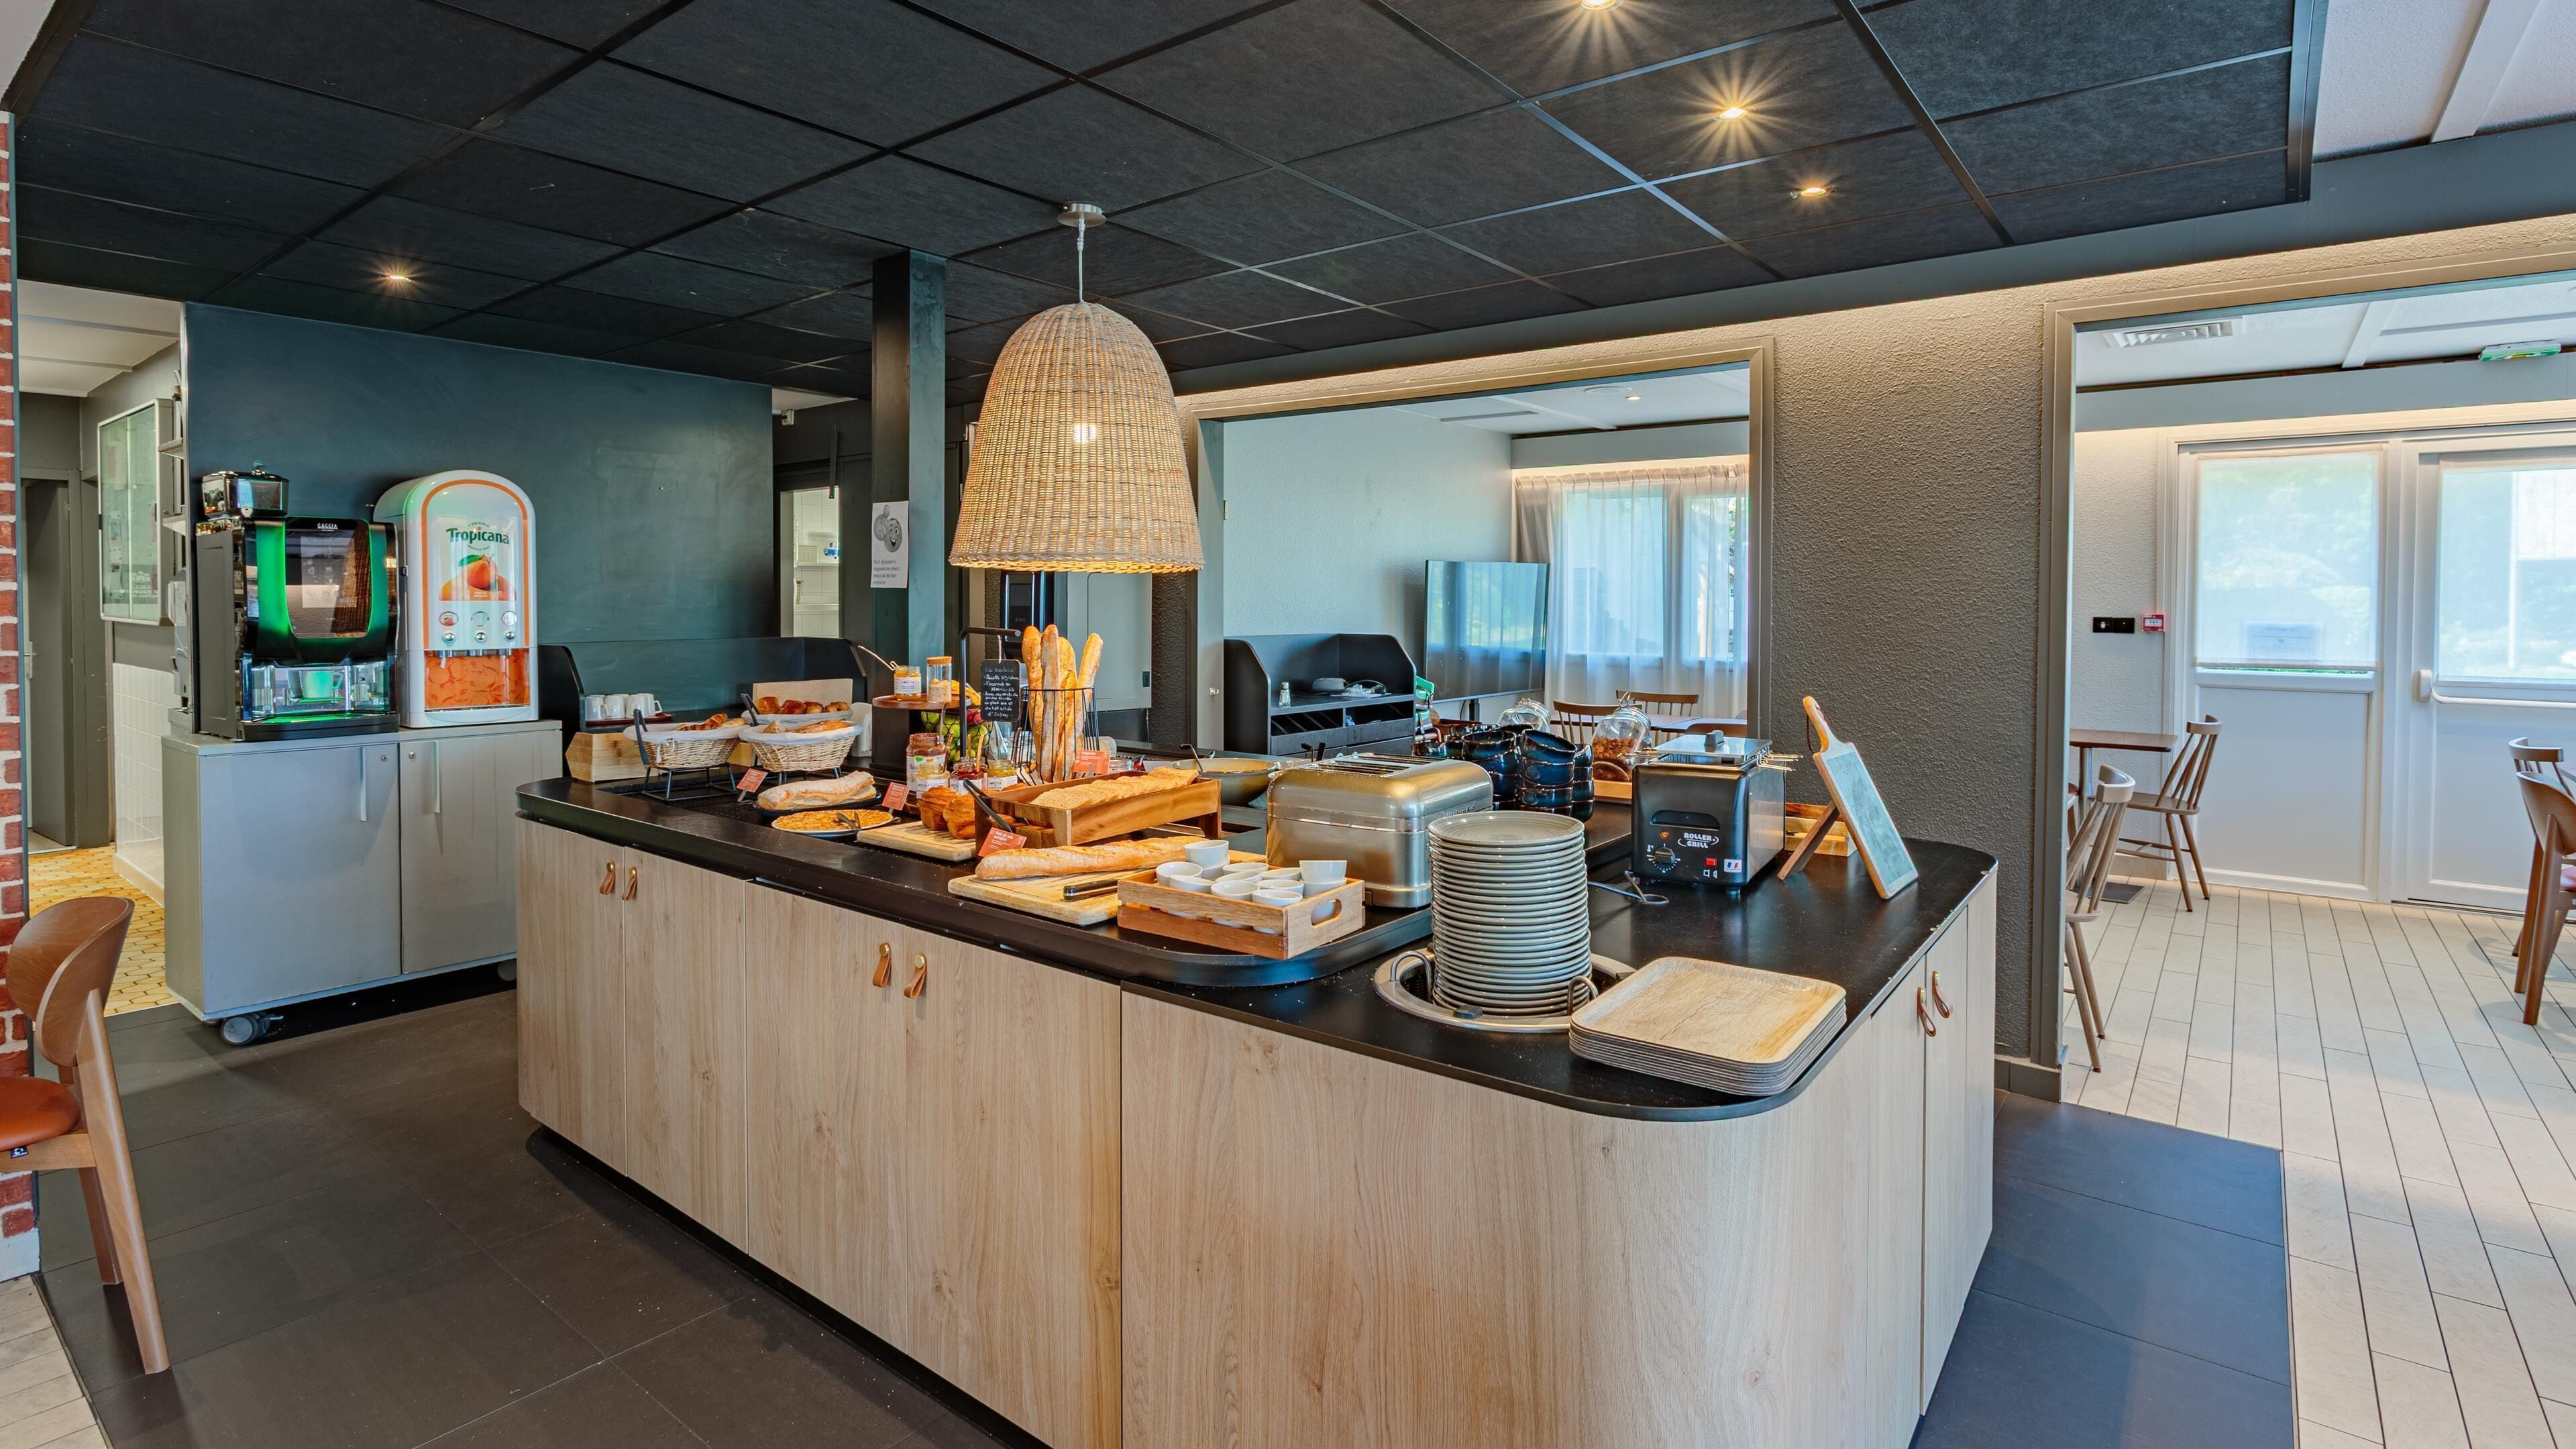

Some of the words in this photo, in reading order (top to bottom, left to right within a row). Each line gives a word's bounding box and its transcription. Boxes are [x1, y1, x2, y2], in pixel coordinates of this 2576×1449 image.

[446, 528, 510, 544] Tropicana
[1684, 833, 1712, 841] ROLLER
[1686, 841, 1709, 849] GRILL
